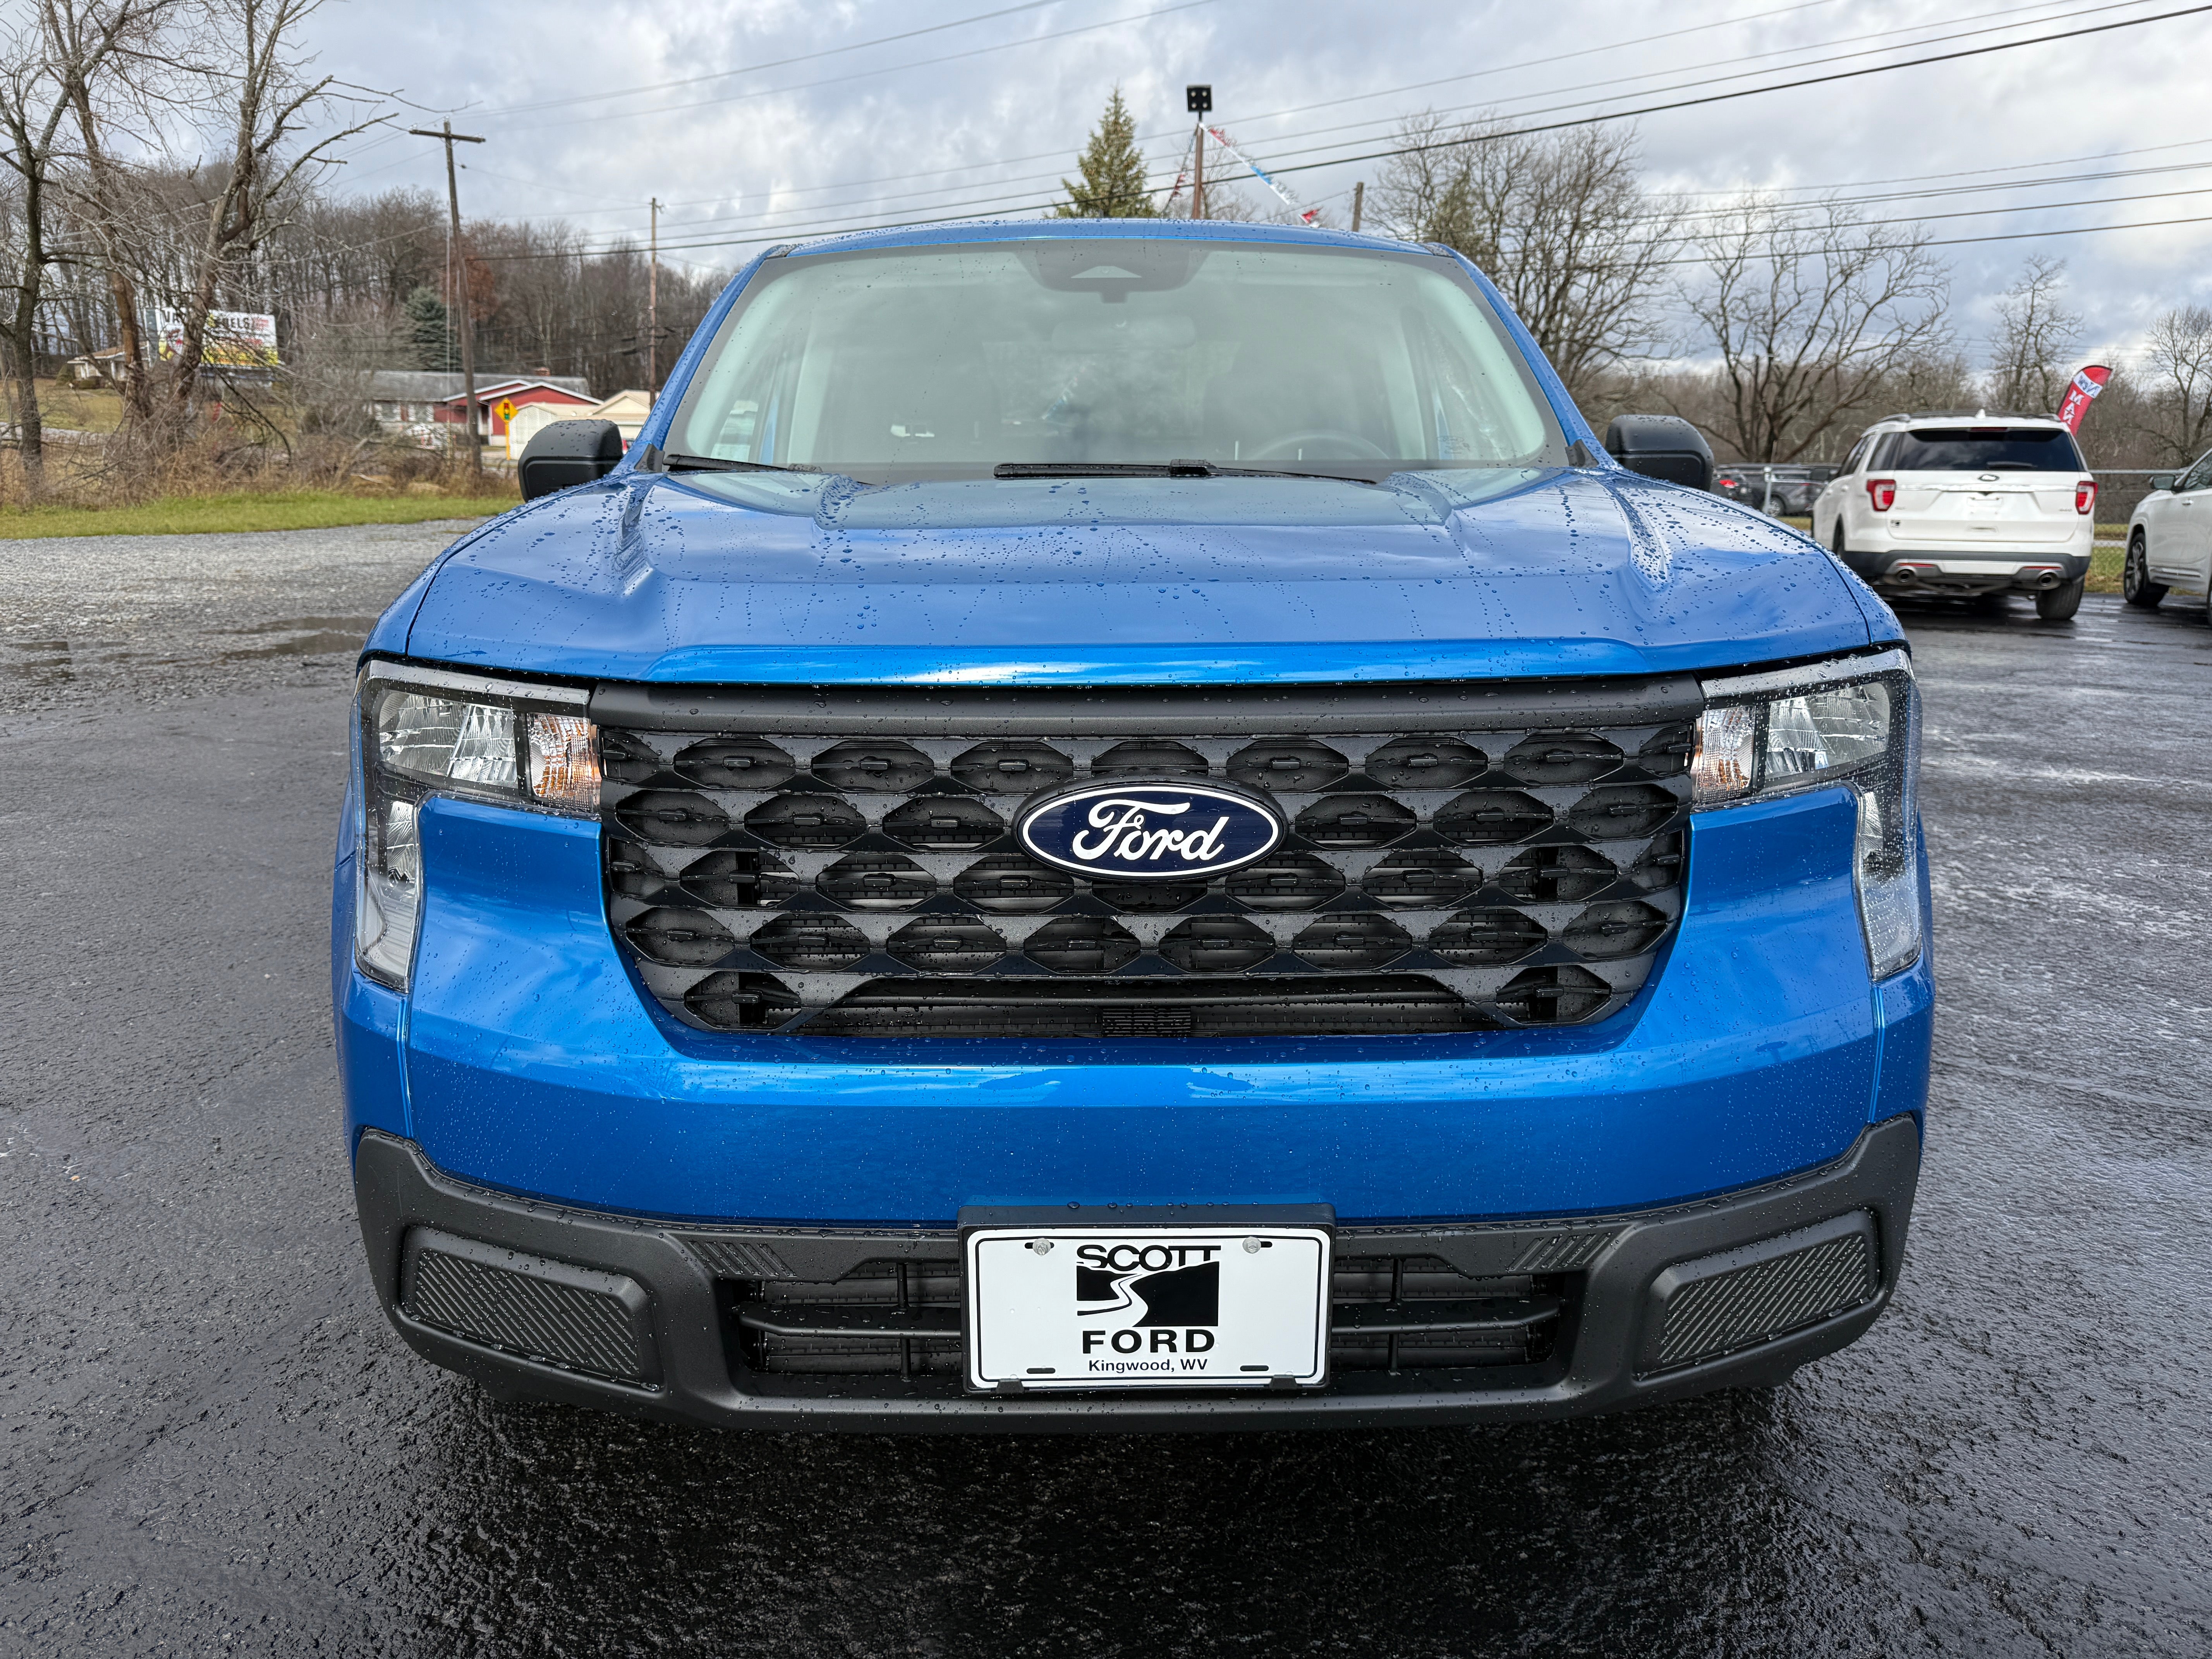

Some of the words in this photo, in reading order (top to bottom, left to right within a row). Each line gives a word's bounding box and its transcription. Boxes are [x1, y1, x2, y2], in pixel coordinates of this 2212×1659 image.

[1072, 799, 1230, 860] Ford
[1076, 1244, 1221, 1271] SCOTT
[1082, 1329, 1215, 1354] FORD
[1089, 1359, 1174, 1374] Kingwood,
[1180, 1358, 1207, 1370] WV
